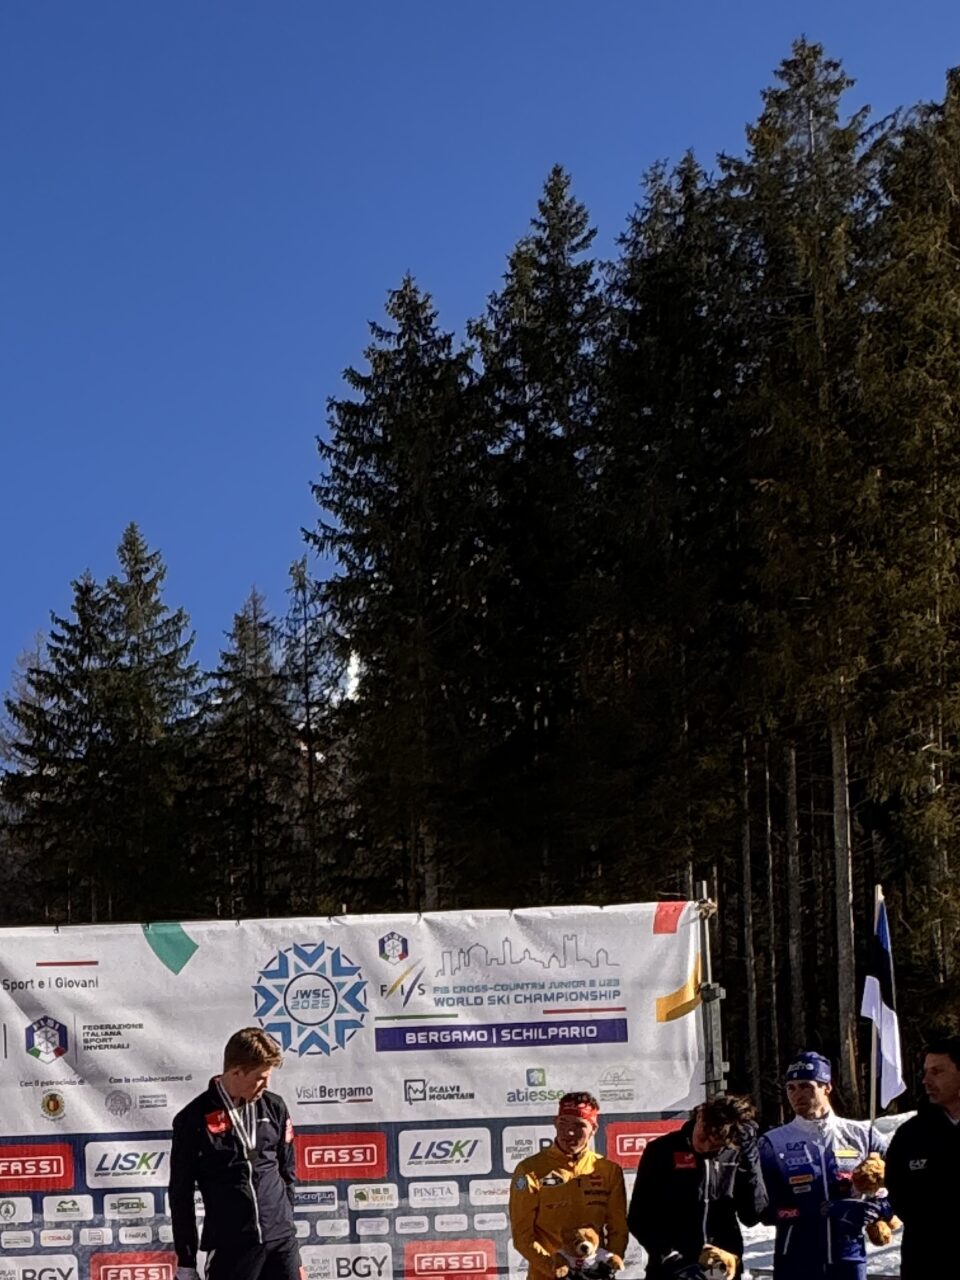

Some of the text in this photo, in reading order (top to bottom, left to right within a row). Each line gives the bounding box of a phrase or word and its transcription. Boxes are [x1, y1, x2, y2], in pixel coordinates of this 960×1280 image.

[2, 978, 34, 993] Sport
[38, 981, 45, 990] e
[55, 977, 99, 990] Giovani
[433, 986, 449, 995] FIS
[452, 981, 546, 994] CROSS-COUNTRY
[548, 980, 586, 989] JUNIOR
[292, 988, 330, 1000] JWSC
[433, 989, 621, 1008] WORLD SKI CHAMPIONSHIP
[290, 999, 330, 1010] 2025
[82, 1022, 143, 1033] FEDERAZIONE
[82, 1030, 122, 1038] ITALIANA
[405, 1025, 598, 1045] BERGAMO SCHILPARIO
[296, 1084, 374, 1101] VisitBergamo
[507, 1088, 566, 1103] atiesse
[311, 1149, 371, 1163] FASSI
[409, 1140, 479, 1160] LISKI
[95, 1152, 165, 1172] LISKI
[909, 1159, 928, 1169] EA7
[413, 1186, 453, 1198] PINETA
[335, 1255, 388, 1278] BGY
[420, 1255, 481, 1270] FASSI
